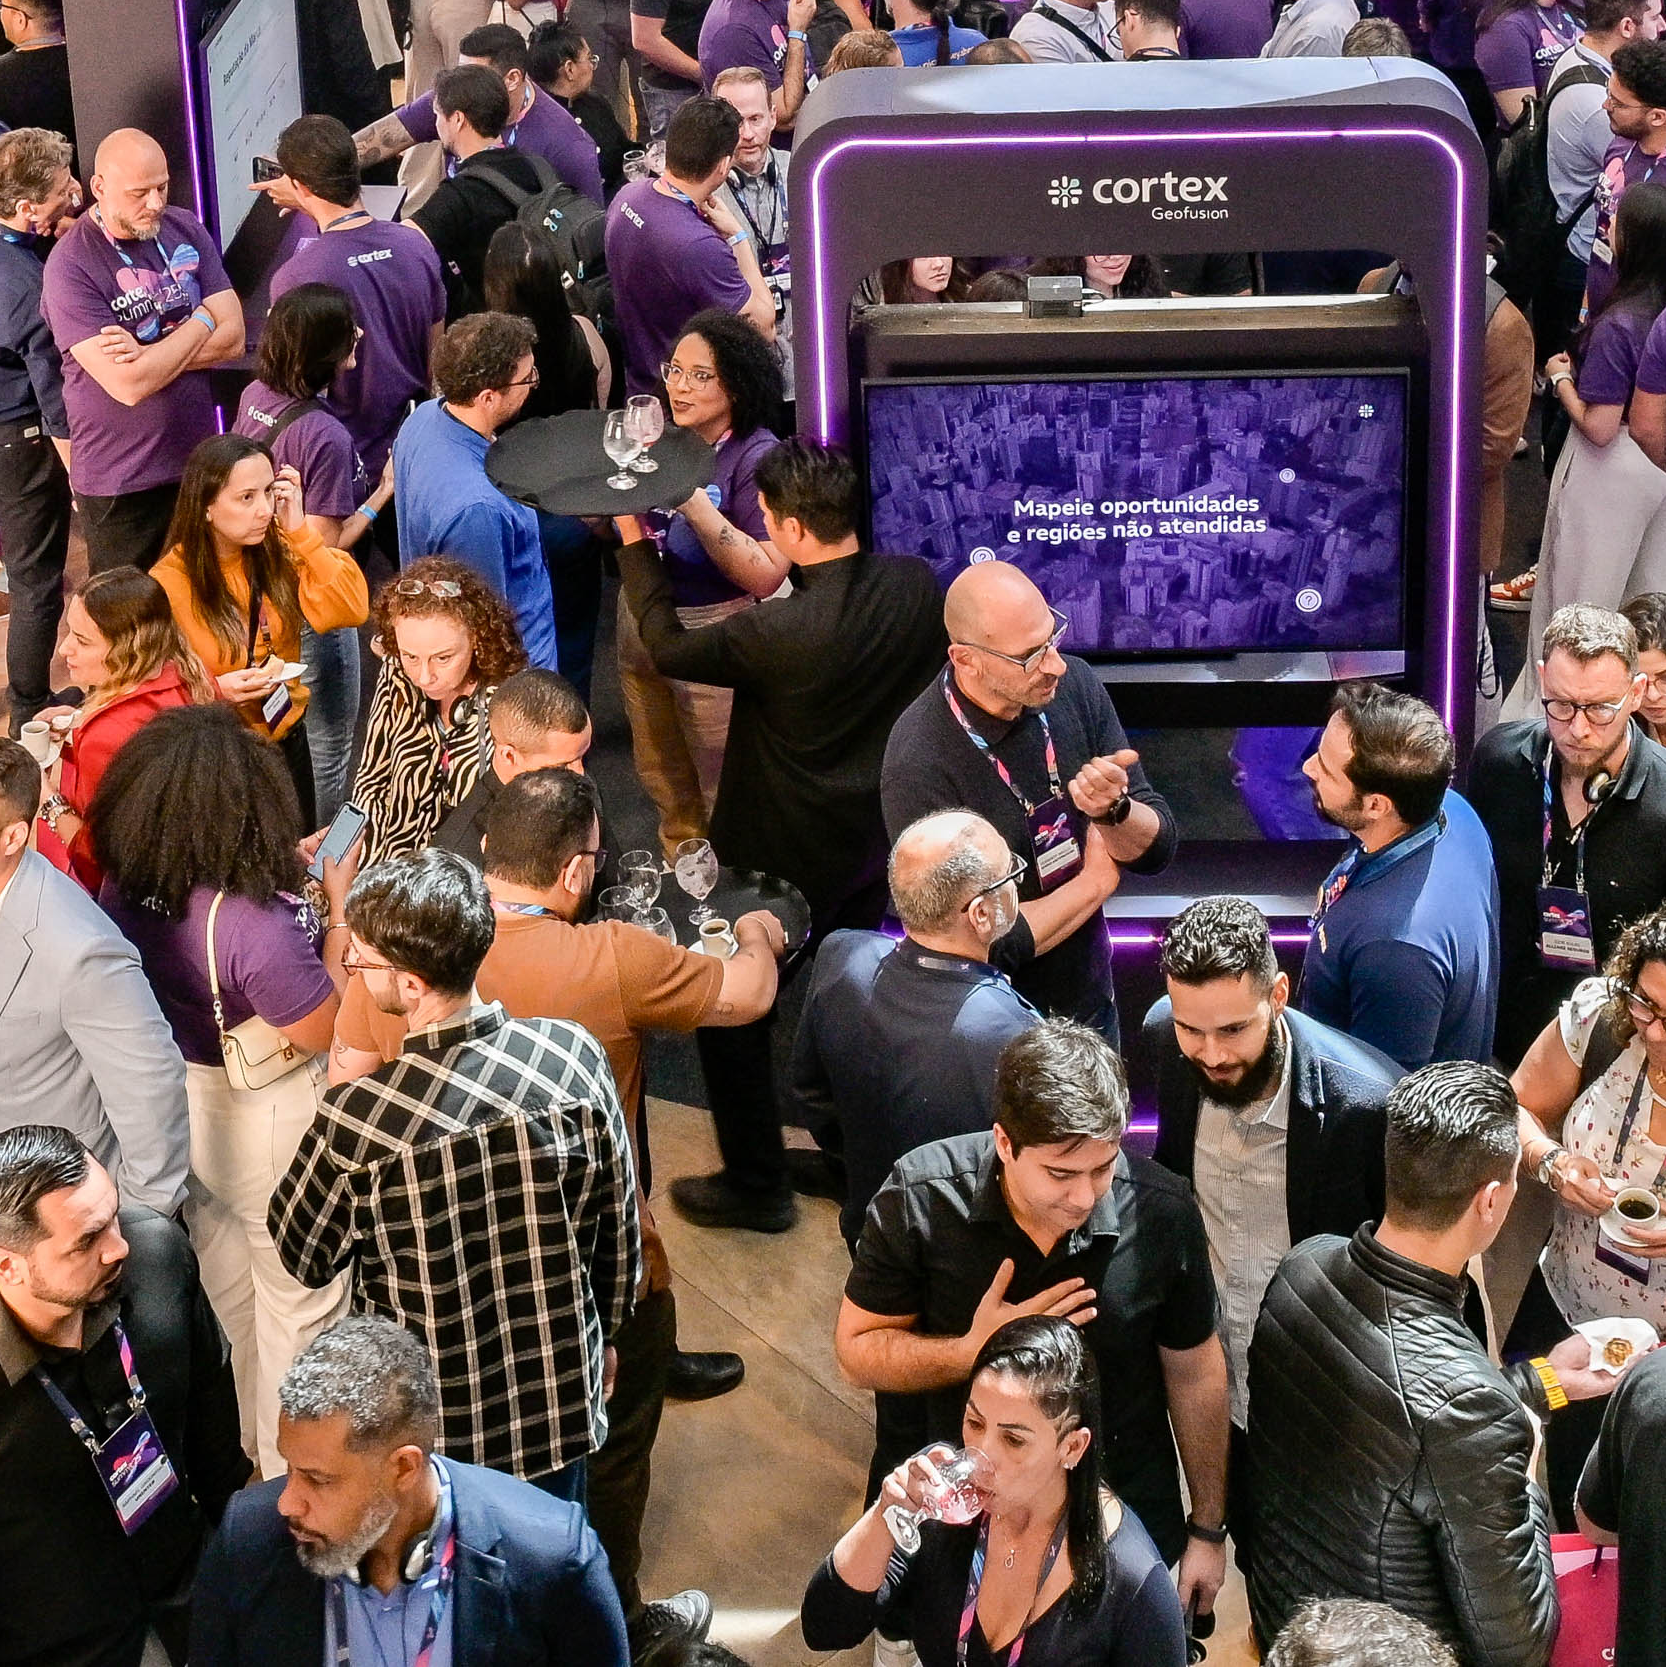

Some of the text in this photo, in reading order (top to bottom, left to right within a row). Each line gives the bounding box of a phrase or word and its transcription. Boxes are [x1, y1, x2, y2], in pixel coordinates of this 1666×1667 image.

[1092, 170, 1228, 204] cortex
[1151, 206, 1229, 222] Geofusion
[357, 249, 393, 264] cortex
[111, 285, 146, 311] corte
[1013, 495, 1260, 522] Mapeie oportunidades
[1007, 515, 1268, 546] e regiões não atendidas
